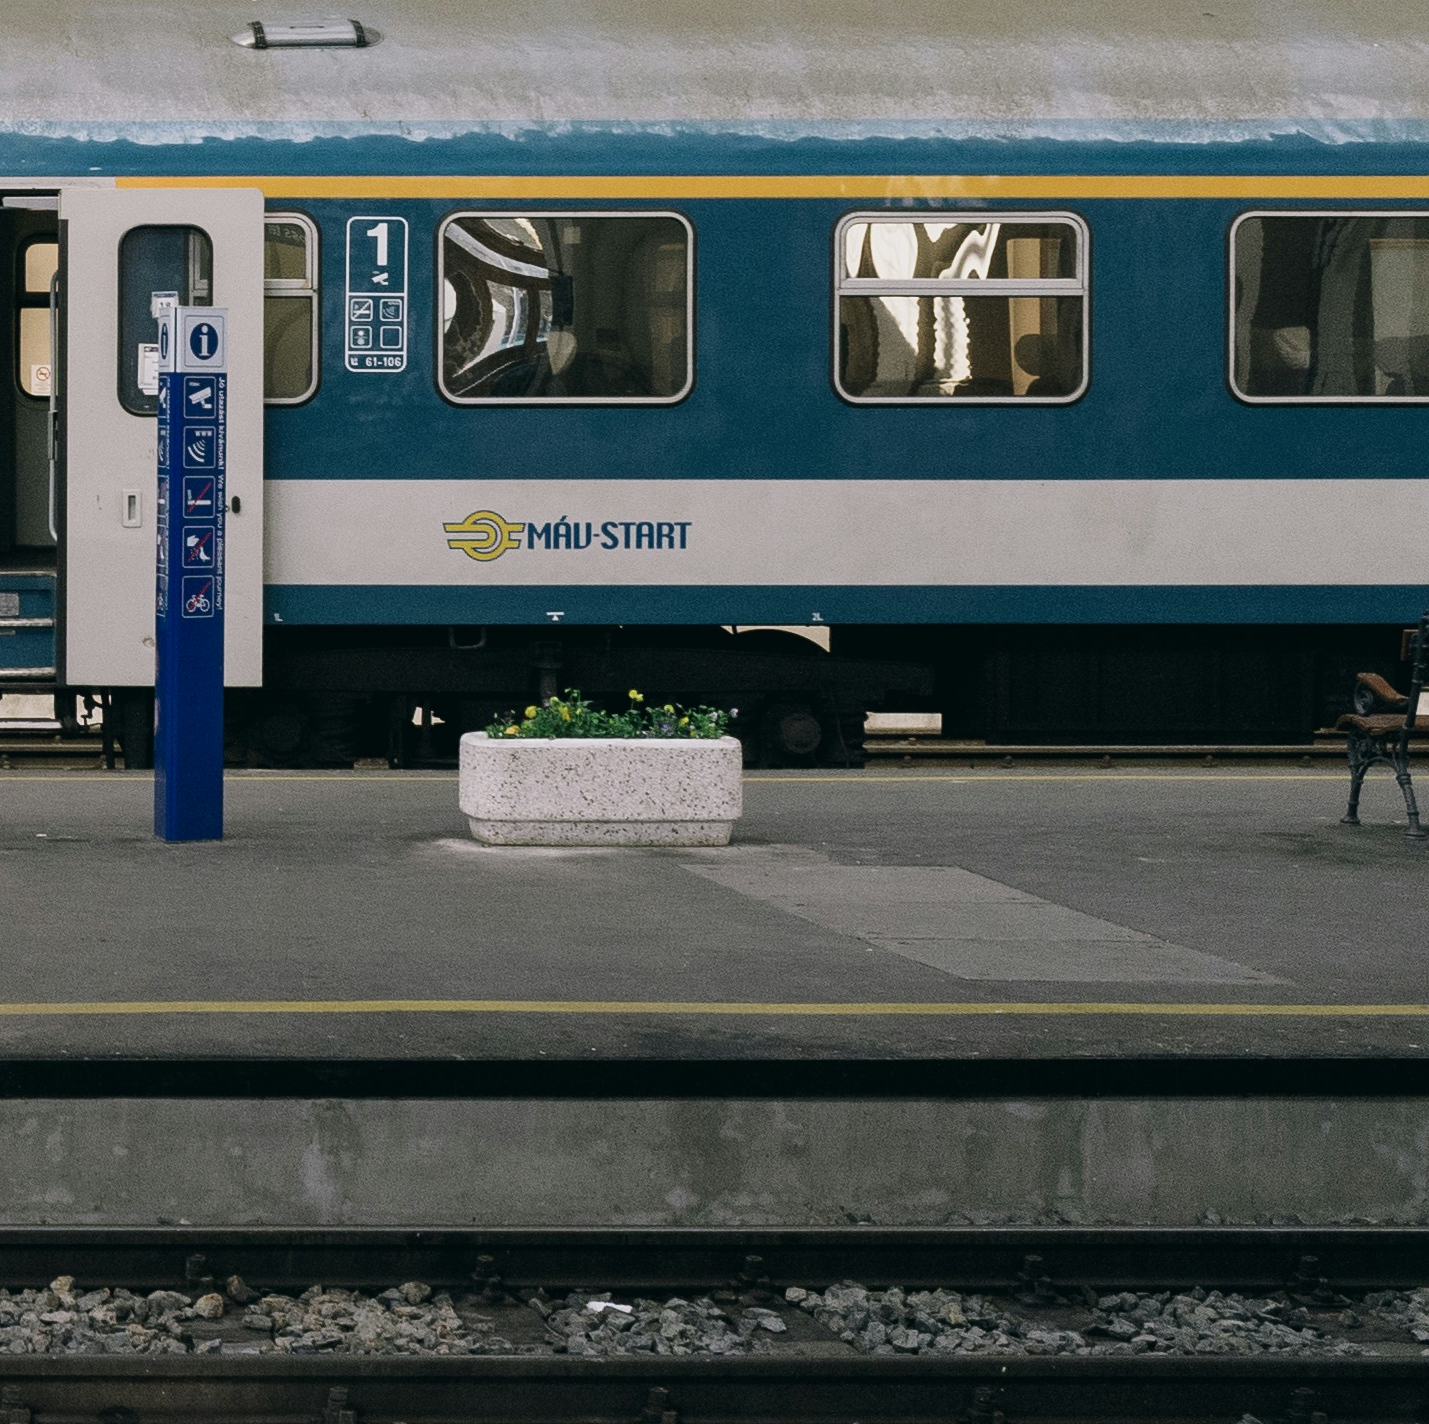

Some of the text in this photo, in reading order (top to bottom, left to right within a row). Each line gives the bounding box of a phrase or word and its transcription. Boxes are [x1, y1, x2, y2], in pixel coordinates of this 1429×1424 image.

[367, 222, 389, 266] 1
[365, 356, 402, 367] 61-106
[527, 515, 693, 549] MÁV-START
